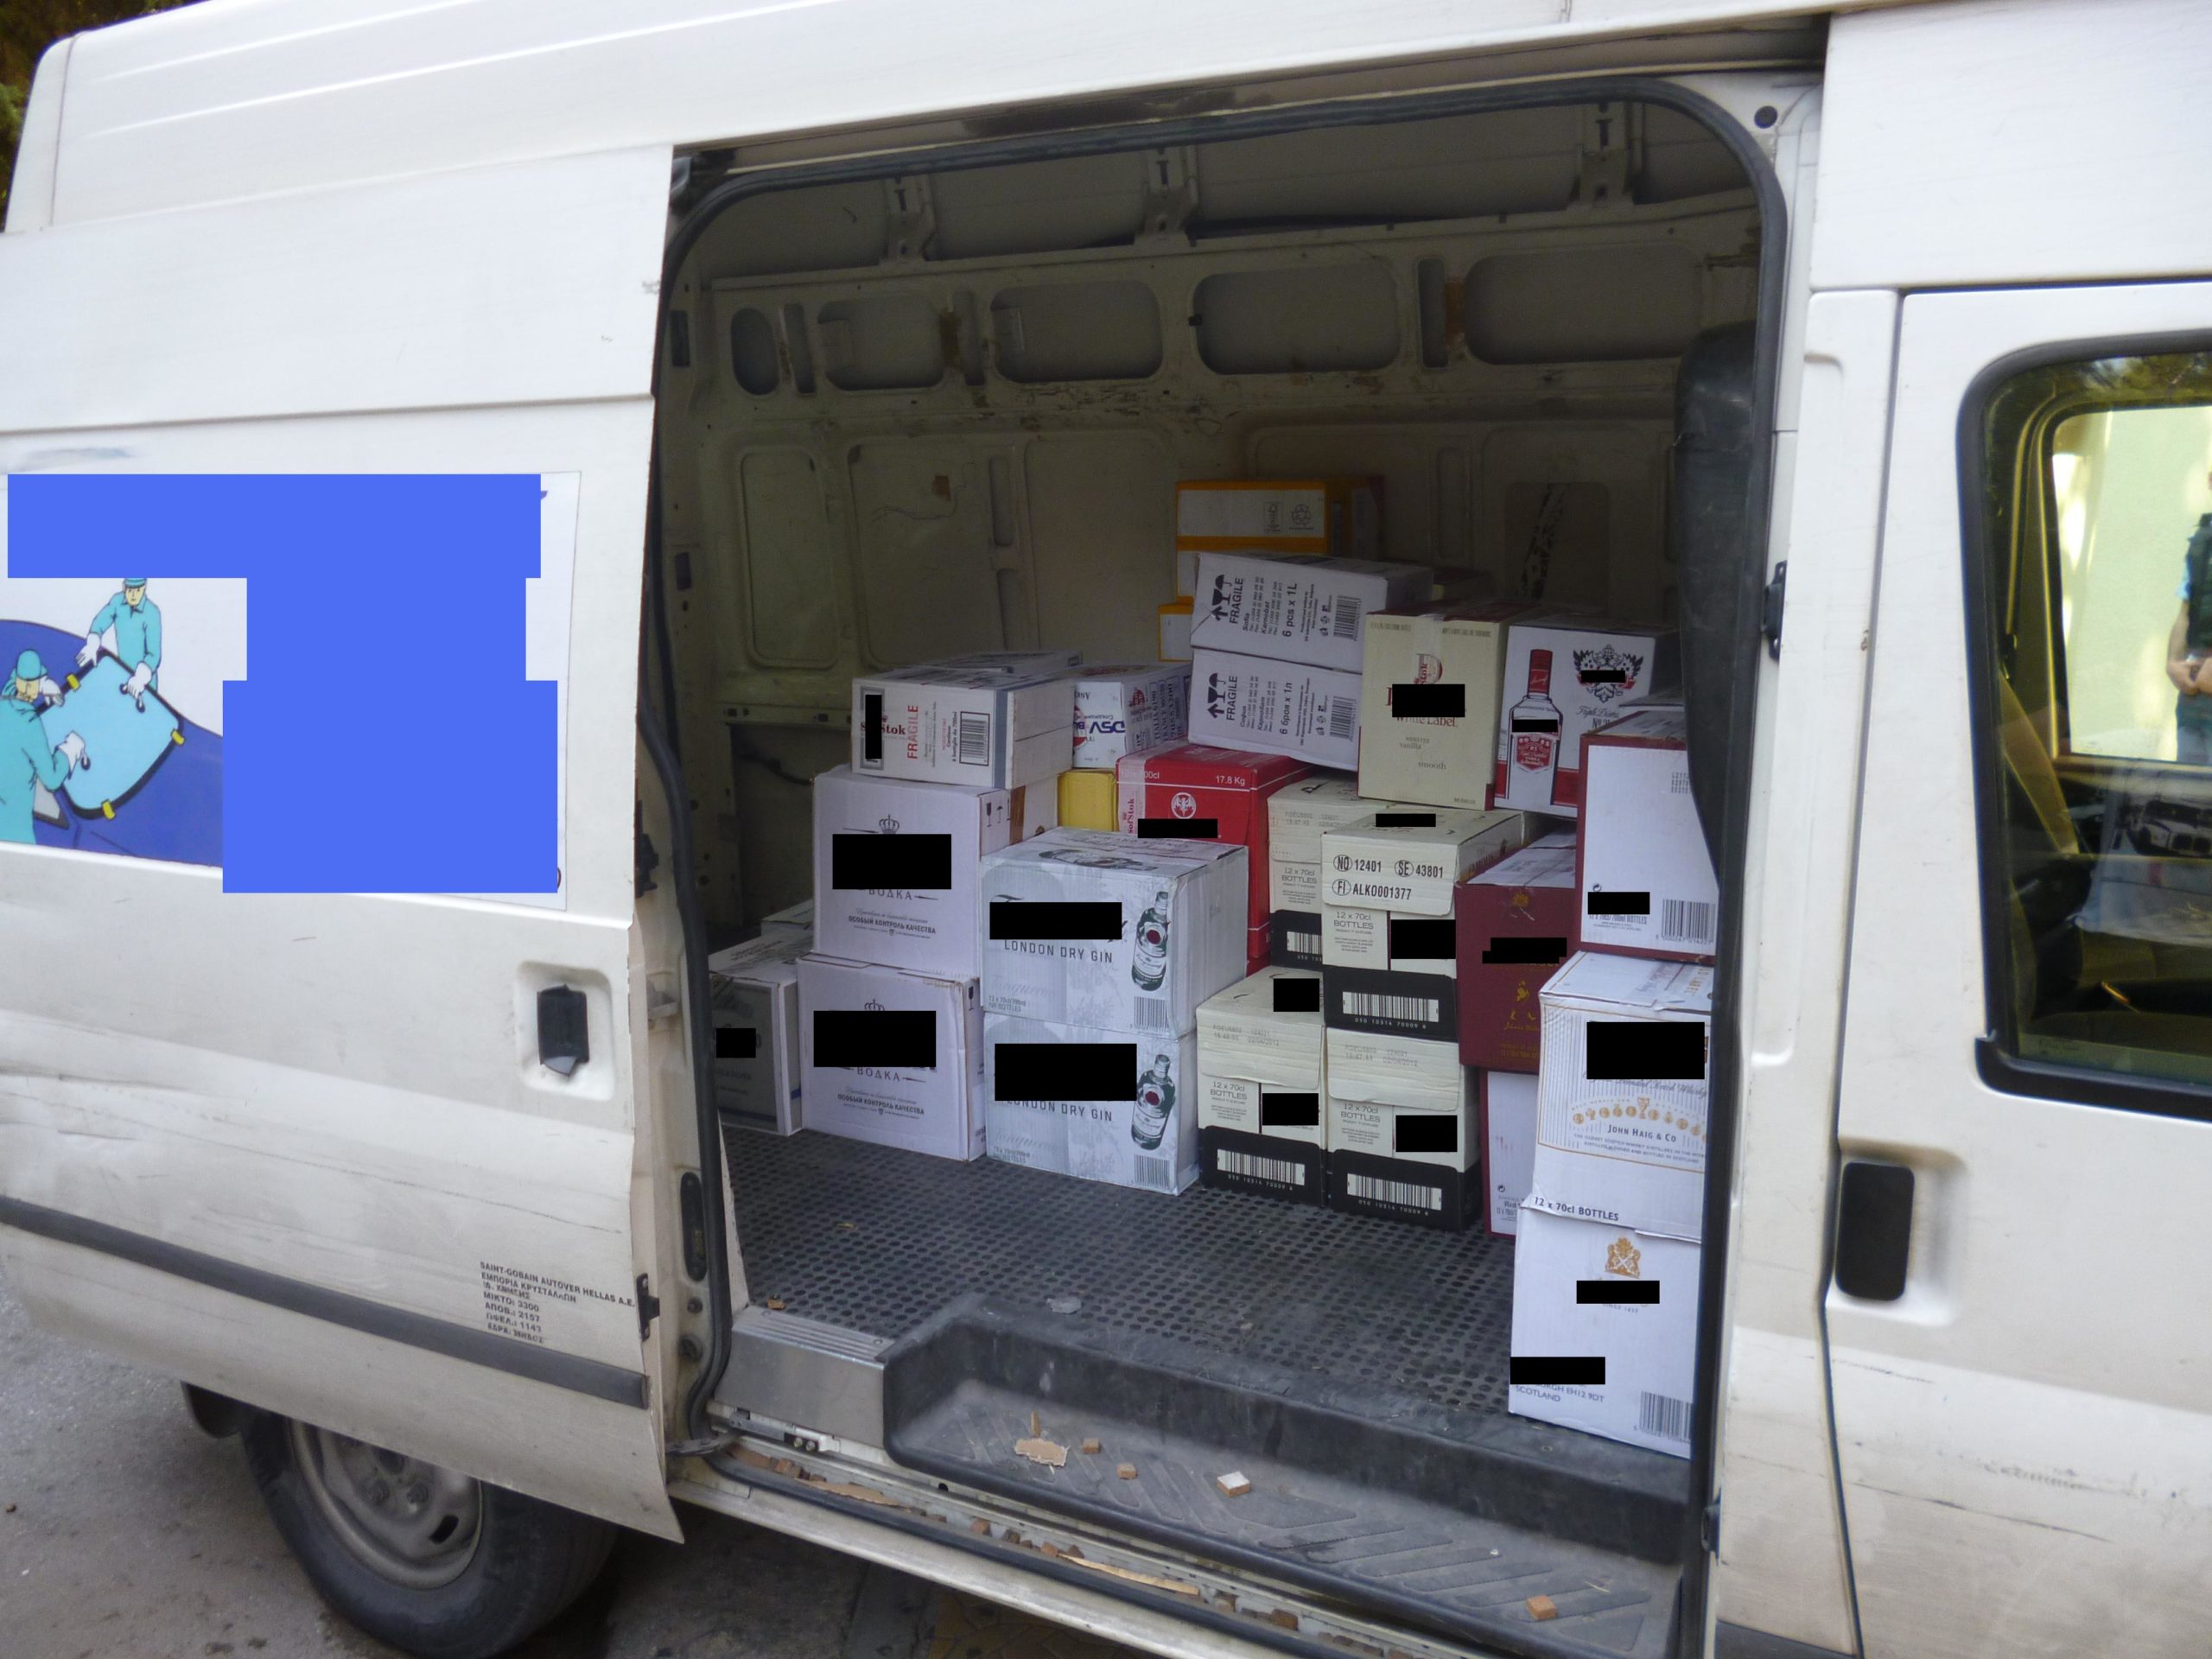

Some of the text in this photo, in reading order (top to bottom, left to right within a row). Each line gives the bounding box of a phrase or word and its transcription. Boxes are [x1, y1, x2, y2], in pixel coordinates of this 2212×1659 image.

[1287, 582, 1298, 596] 1L
[1229, 577, 1243, 625] FRAGILE
[1242, 612, 1250, 632] Sofia
[1286, 609, 1298, 627] pcs
[1226, 675, 1237, 721] FRAGILE
[1280, 704, 1292, 726] броя
[907, 705, 918, 759] FRAGILE
[1089, 721, 1126, 734] DSV
[1418, 760, 1447, 771] smooth
[1216, 775, 1233, 785] 17.8
[1234, 776, 1245, 786] Kg
[1337, 856, 1443, 879] NO 12401 SE 43801
[1281, 874, 1317, 884] BOTTLES
[1338, 880, 1345, 894] FI
[1337, 911, 1345, 919] 12
[849, 915, 874, 925] ОСОБЫЙ
[874, 919, 905, 930] КОНТРОЛЬ
[906, 924, 936, 935] КАЧЕСТВА
[1333, 919, 1374, 930] BOTTLES
[1004, 939, 1113, 963] LONDON DRY GIN
[856, 1066, 900, 1082] ВОДКА
[1210, 1089, 1247, 1100] BOTTLES
[1230, 1083, 1245, 1091] 70cl
[837, 1093, 863, 1103] ОСОБЫЙ
[864, 1098, 893, 1109] КОНТРОЛЬ
[894, 1104, 925, 1116] КАЧЕСТВА
[1061, 1103, 1084, 1117] DRY
[1091, 1109, 1113, 1122] GIN
[1363, 1105, 1378, 1114] 70cl
[1341, 1111, 1381, 1122] BOTTLES
[1534, 1196, 1545, 1207] 12
[1555, 1202, 1575, 1215] 70cl
[1578, 1205, 1619, 1222] BOTTLES
[480, 1261, 635, 1307] SAINT-GOBAIN AUTOVER HELLAS A.E.
[481, 1271, 576, 1303] ΕΜΠΟΡΙΑ ΚΡΥΣΤΑΛΛΩΝ
[483, 1290, 539, 1313] ΜΙΚΤΟ: 3300
[485, 1301, 540, 1323] ΑΠΟΒ.: 2157
[487, 1322, 512, 1335] ΕΔΡΑ:
[1515, 1384, 1561, 1403] SCOTLAND
[1566, 1385, 1586, 1399] EH12
[1587, 1391, 1605, 1403] 9DT
